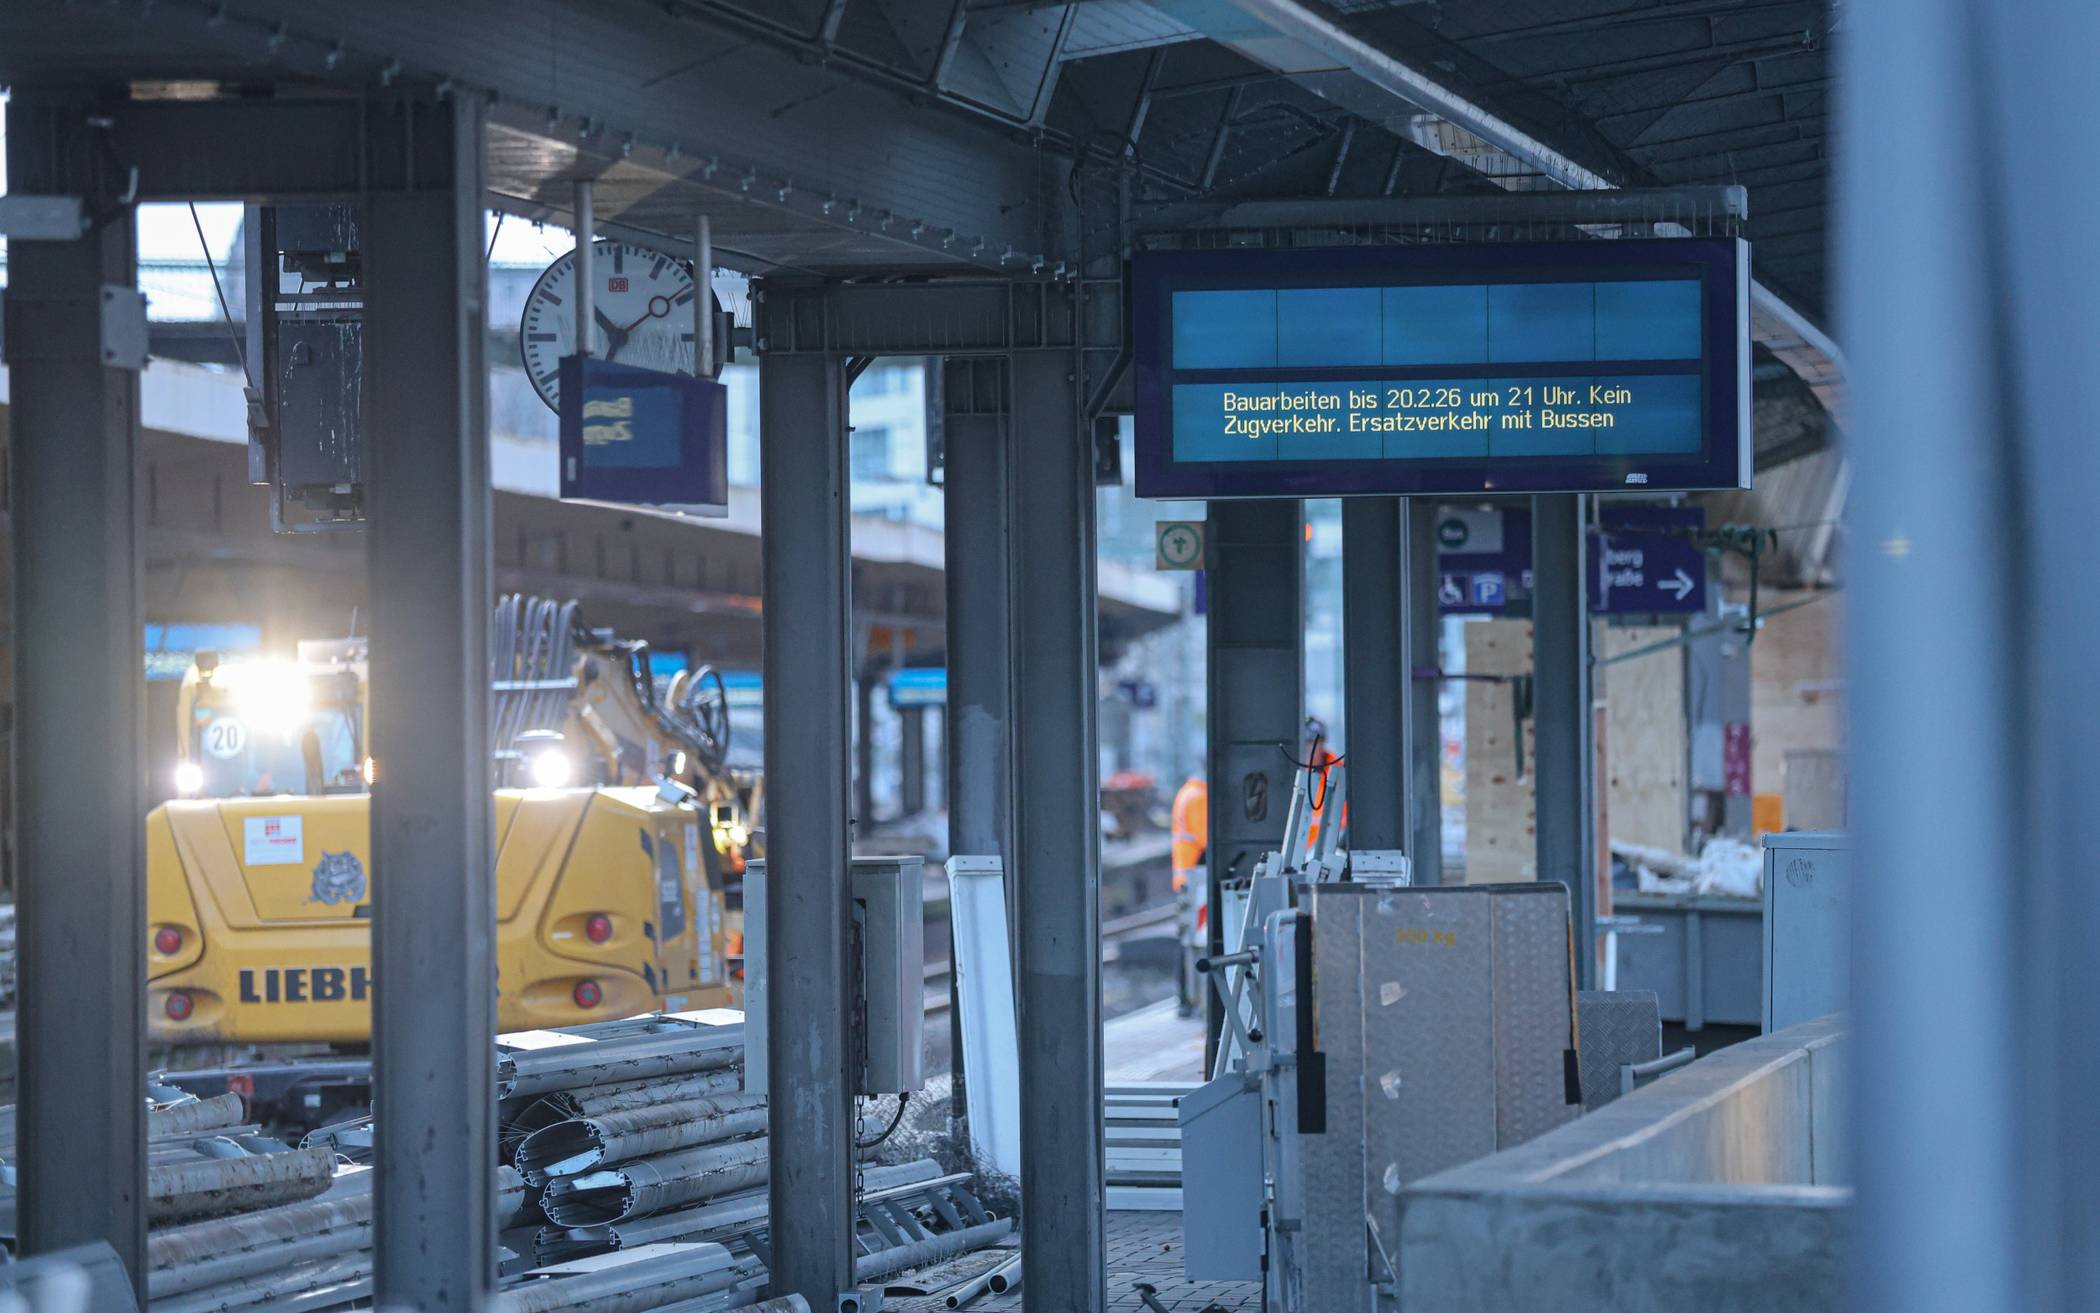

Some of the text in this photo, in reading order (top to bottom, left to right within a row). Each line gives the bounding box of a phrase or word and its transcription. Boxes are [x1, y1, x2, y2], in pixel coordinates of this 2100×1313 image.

[610, 279, 627, 291] DB
[1223, 384, 1632, 411] Bauarbeiten bis 20.2.26 um 21 Uhr. Kein
[1224, 409, 1614, 439] Zugverkehr. Ersatzverkehr mit Bussen
[1606, 549, 1643, 568] berg
[212, 725, 238, 751] 20
[239, 967, 374, 1004] LIEBH
